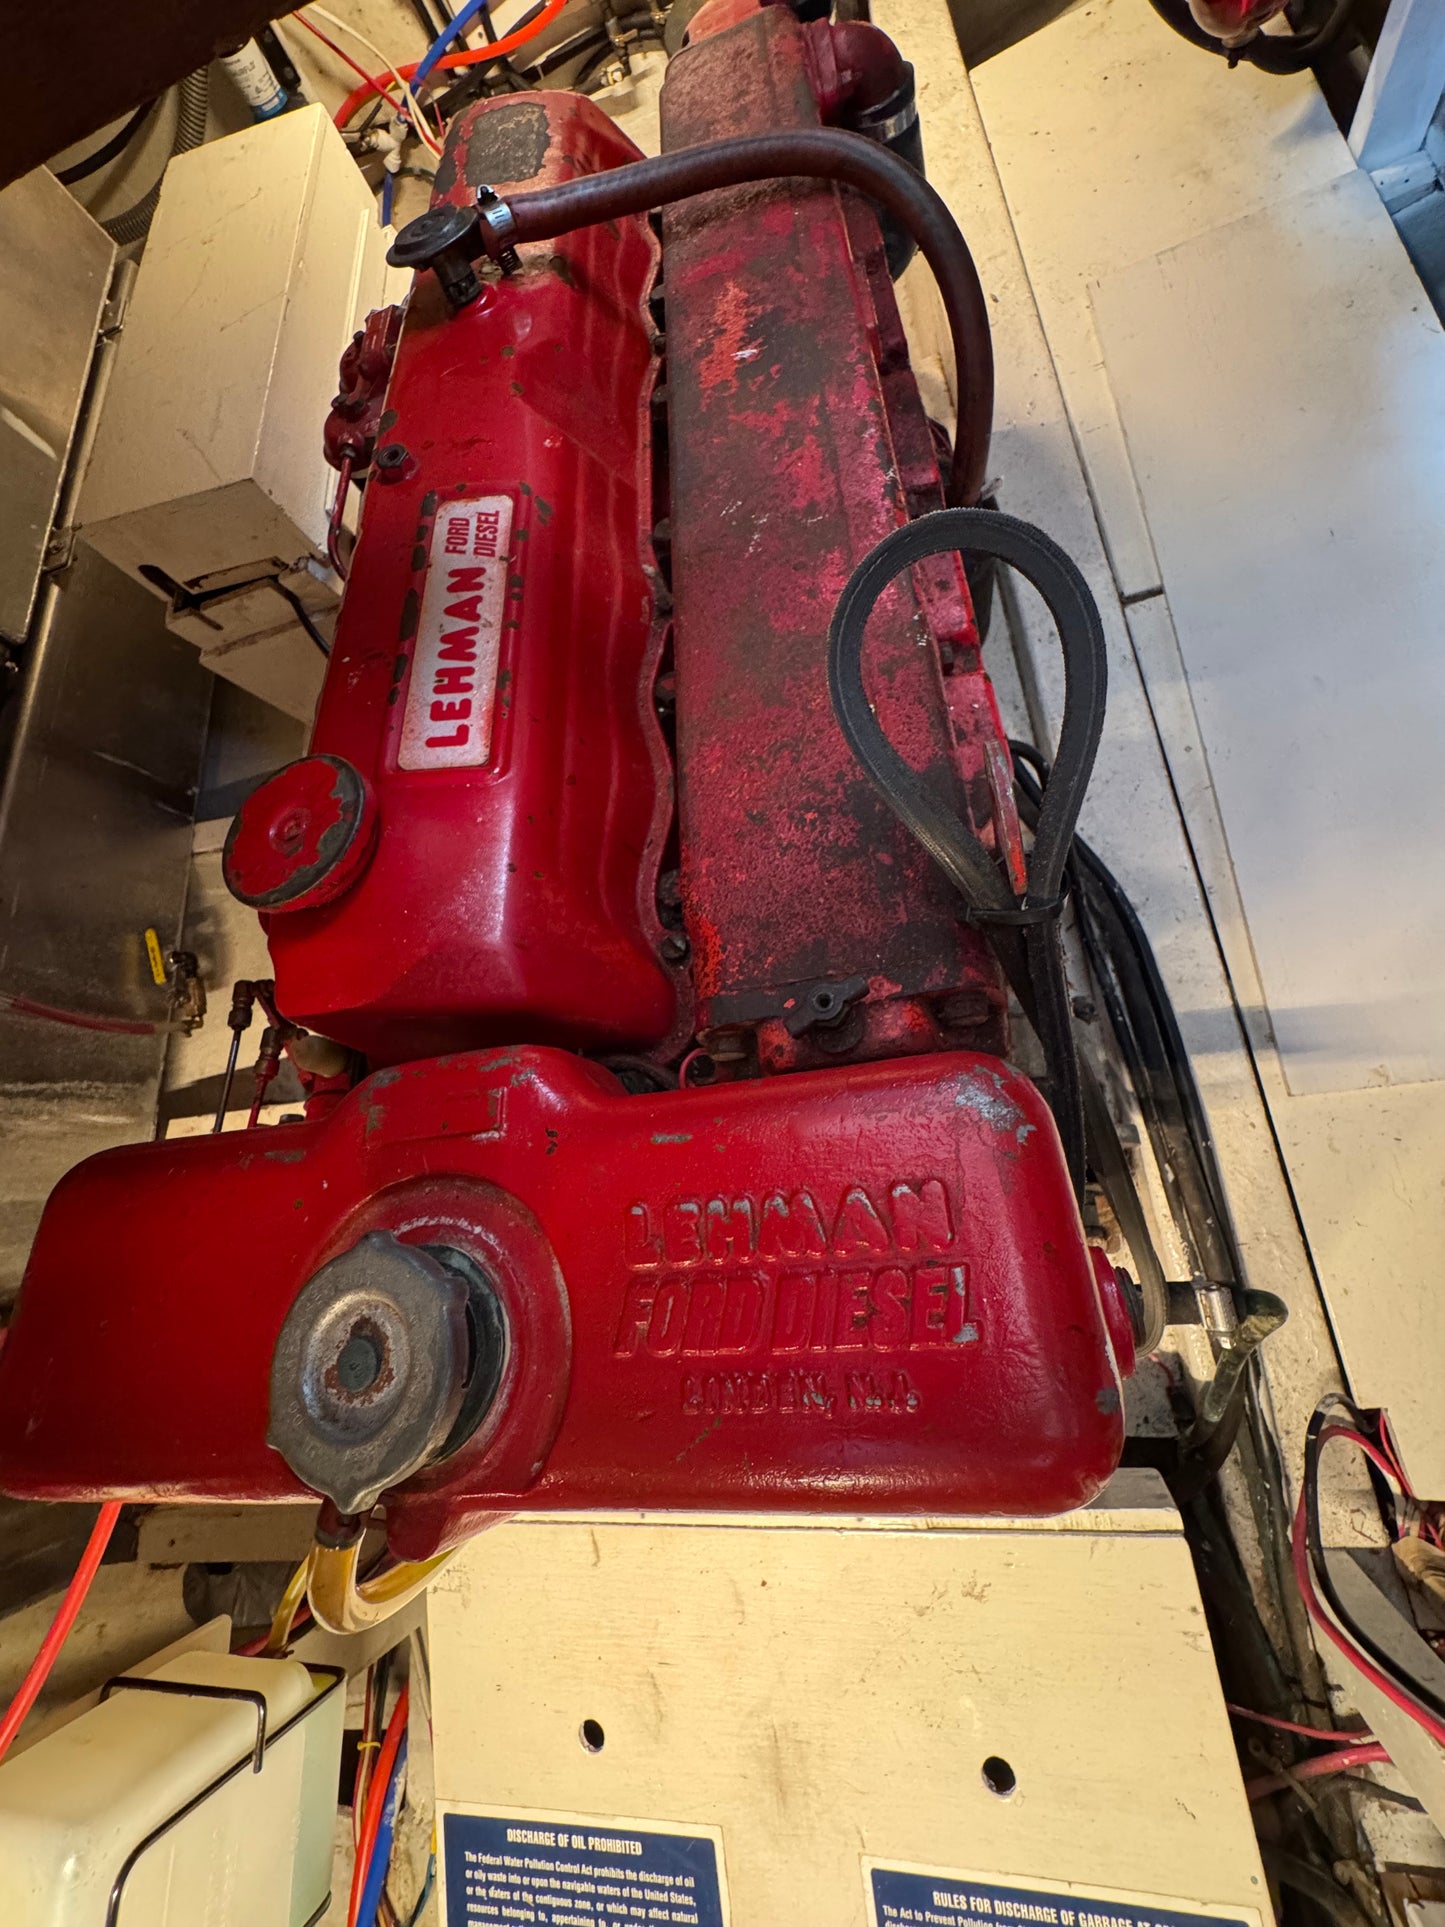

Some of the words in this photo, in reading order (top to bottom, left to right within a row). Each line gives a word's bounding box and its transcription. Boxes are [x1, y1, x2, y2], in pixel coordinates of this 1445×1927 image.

[444, 516, 471, 555] FORD
[473, 510, 500, 558] DIESEL
[425, 566, 487, 748] LEHMAN
[624, 1180, 955, 1270] LEHMAN
[613, 1268, 766, 1358] FORD
[771, 1262, 983, 1354] DIESEL
[507, 1828, 556, 1847] DISCHARGE
[557, 1833, 570, 1848] OF
[571, 1835, 587, 1850] OIL
[588, 1836, 643, 1856] PROHIBITED
[464, 1851, 477, 1863] The
[478, 1853, 503, 1866] Federal
[503, 1856, 524, 1868] Water
[524, 1858, 555, 1871] Pollution
[555, 1861, 580, 1874] Control
[581, 1863, 593, 1875] Act
[594, 1866, 625, 1880] prohibits
[625, 1869, 637, 1881] the
[639, 1870, 674, 1887] discharge
[675, 1875, 684, 1887] of
[684, 1876, 695, 1888] oil
[465, 1869, 473, 1879] or
[473, 1870, 486, 1883] oily
[487, 1871, 507, 1884] waste
[508, 1873, 521, 1885] into
[522, 1876, 531, 1885] or
[531, 1877, 549, 1889] upon
[549, 1877, 561, 1889] the
[562, 1881, 596, 1894] navigable
[597, 1884, 621, 1897] waters
[622, 1886, 630, 1898] of
[631, 1886, 643, 1899] the
[644, 1888, 669, 1903] United
[670, 1891, 697, 1907] States,
[466, 1886, 474, 1895] or
[475, 1885, 486, 1897] the
[513, 1891, 521, 1901] of
[522, 1891, 534, 1903] the
[535, 1894, 573, 1908] contiguous
[574, 1899, 594, 1912] zone,
[596, 1902, 604, 1912] or
[606, 1902, 628, 1915] which
[630, 1906, 646, 1919] may
[648, 1907, 670, 1920] affect
[671, 1911, 699, 1925] natural
[466, 1903, 499, 1916] resources
[502, 1905, 535, 1922] belonging
[538, 1910, 548, 1923] to,
[551, 1913, 596, 1927] appertaining
[598, 1918, 608, 1927] to
[882, 1904, 898, 1918] The
[900, 1906, 913, 1920] Act
[914, 1909, 923, 1921] to
[925, 1911, 956, 1926] Prevent
[933, 1891, 968, 1911] RULES
[969, 1896, 992, 1915] FOR
[994, 1899, 1059, 1924] DISCHARGE
[1060, 1909, 1075, 1926] OF
